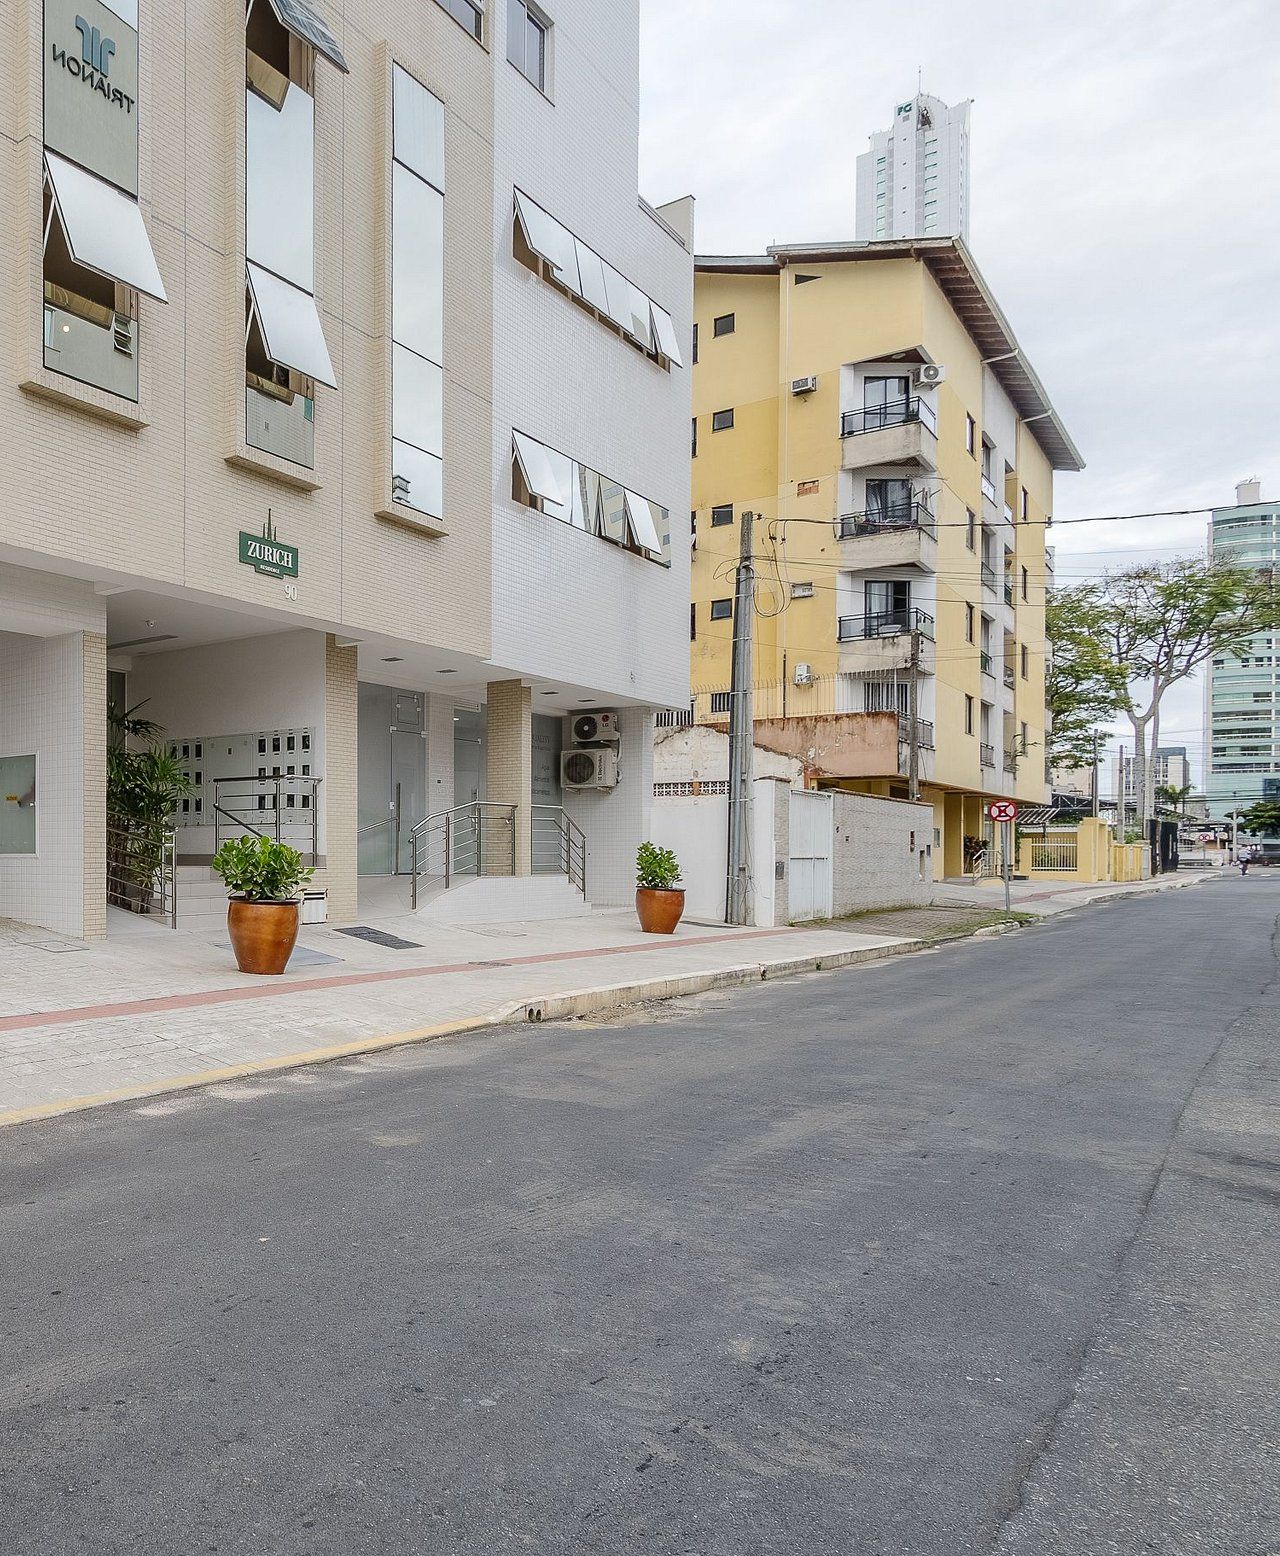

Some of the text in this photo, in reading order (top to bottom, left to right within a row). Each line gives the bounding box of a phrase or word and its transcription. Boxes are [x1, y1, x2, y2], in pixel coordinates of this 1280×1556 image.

[897, 103, 912, 116] FG
[247, 540, 293, 568] ZURICH
[284, 584, 298, 601] 90
